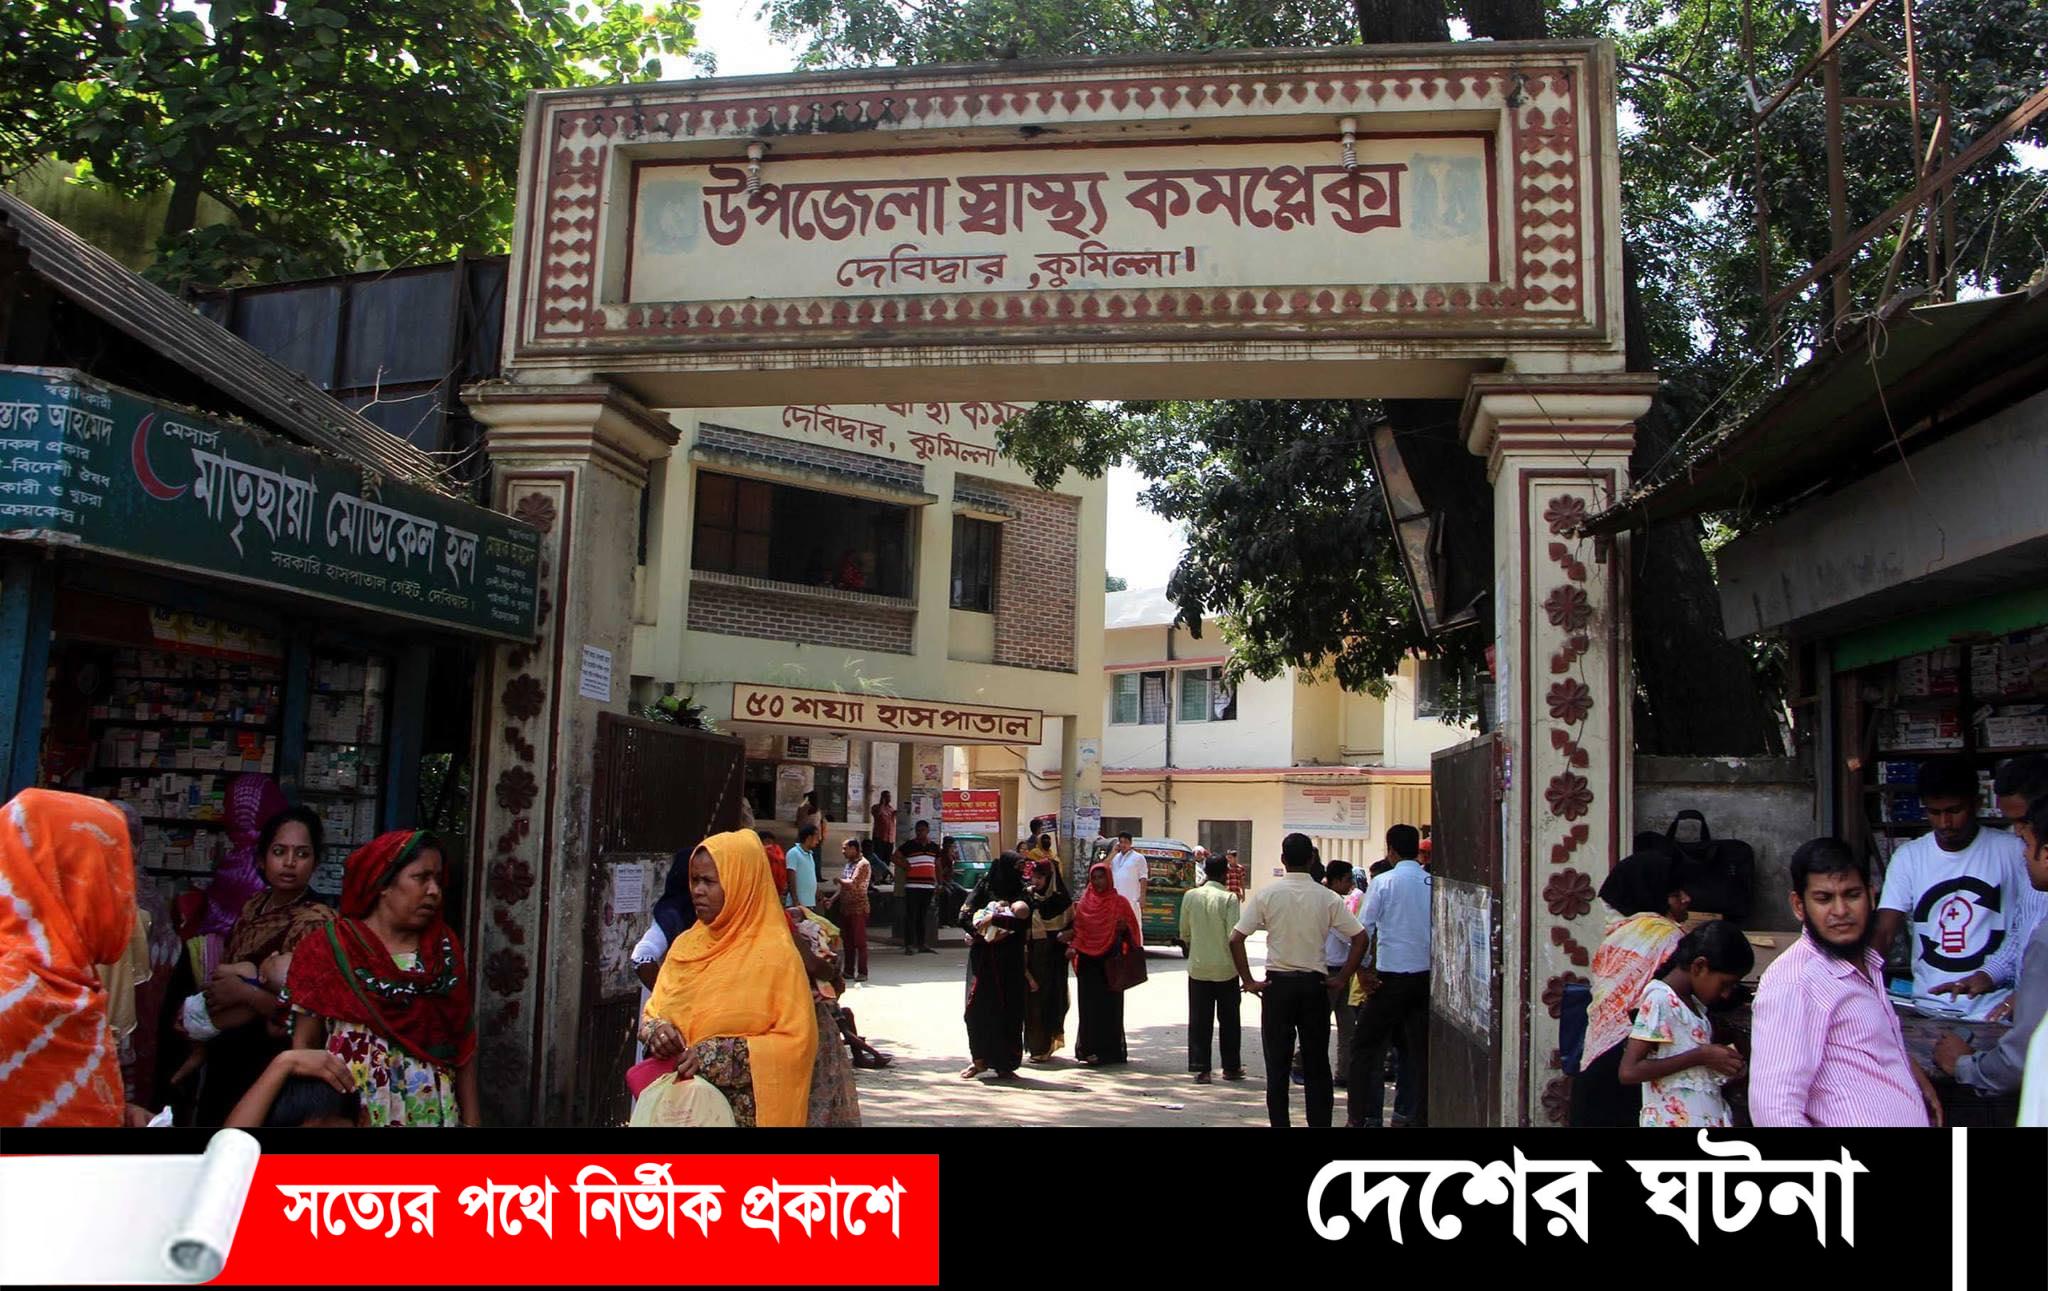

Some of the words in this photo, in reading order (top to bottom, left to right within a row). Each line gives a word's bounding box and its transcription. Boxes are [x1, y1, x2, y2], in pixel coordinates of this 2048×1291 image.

[702, 164, 951, 246] উপজেলা
[957, 172, 1109, 239] স্বাস্থ্য
[1124, 163, 1408, 233] কমপ্লেক্স
[837, 243, 1007, 288] দেবিদ্বার
[163, 421, 222, 449] মেসার্স
[48, 485, 63, 496] ও
[191, 447, 319, 559] মাতৃছায়া
[444, 525, 479, 590] হল
[271, 551, 321, 575] সরকারি
[325, 564, 386, 592] হাসপাতাল
[746, 692, 784, 718] ৫০
[877, 704, 1032, 737] হাসপাতাল
